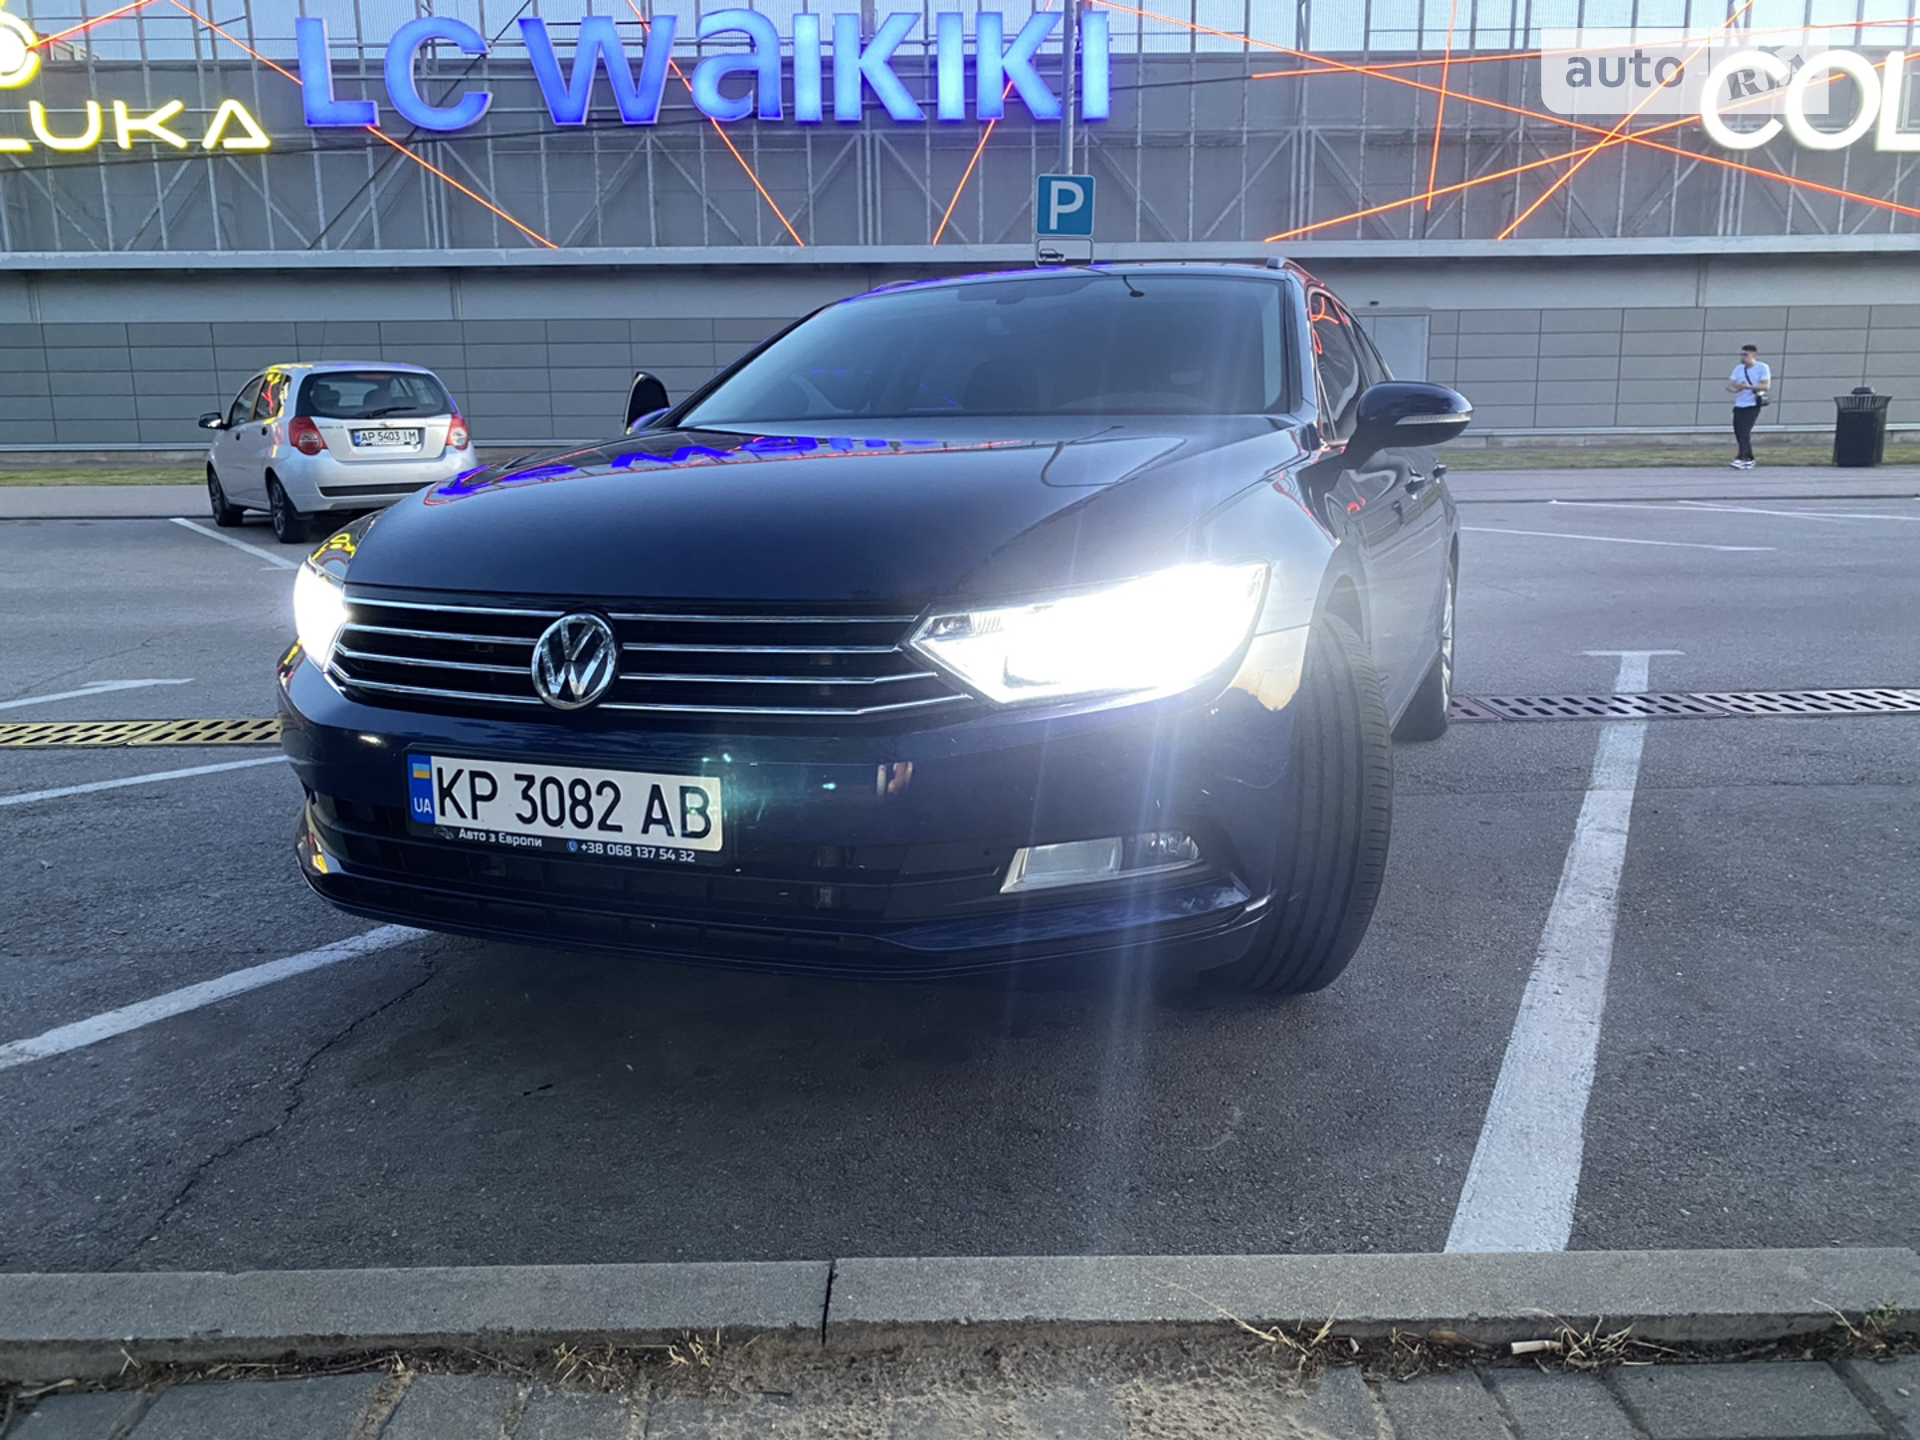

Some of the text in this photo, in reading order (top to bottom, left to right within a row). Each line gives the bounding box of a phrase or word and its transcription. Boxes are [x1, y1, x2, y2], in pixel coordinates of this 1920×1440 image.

[295, 16, 493, 132] LC
[1700, 49, 1920, 152] COL
[1049, 181, 1084, 230] P
[361, 430, 375, 442] AP
[378, 430, 400, 441] 5403
[413, 797, 432, 814] UA
[436, 767, 712, 839] KP 3082 AB
[458, 828, 487, 842] Авто
[488, 832, 496, 843] з
[581, 842, 695, 863] +38 068 137 54 32
